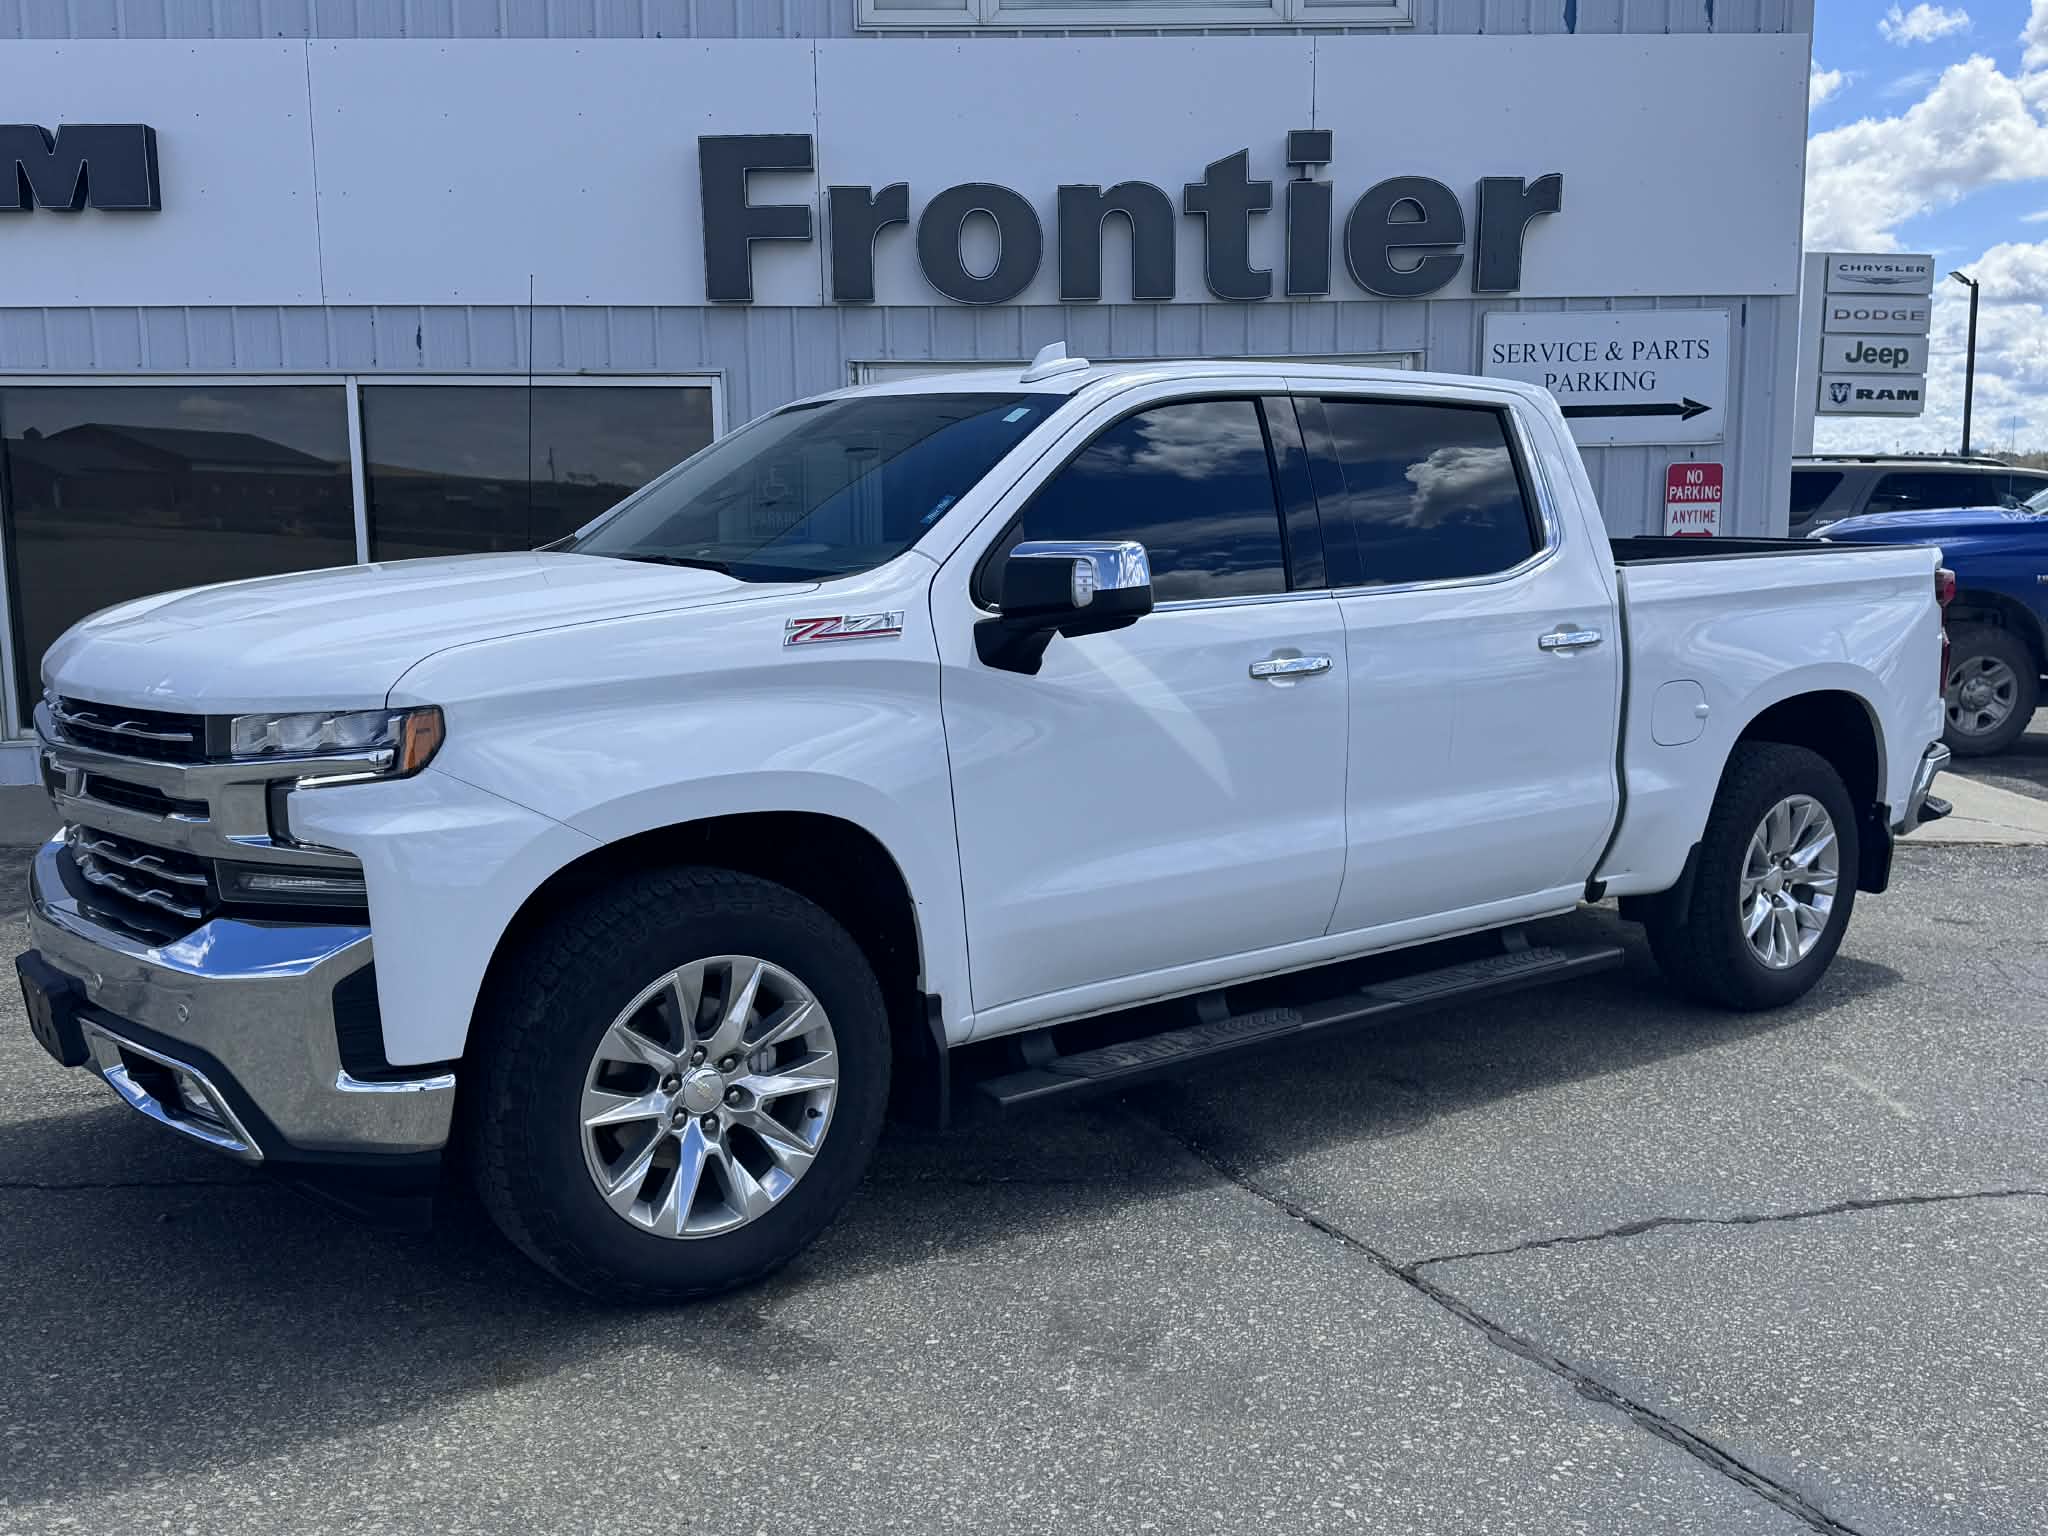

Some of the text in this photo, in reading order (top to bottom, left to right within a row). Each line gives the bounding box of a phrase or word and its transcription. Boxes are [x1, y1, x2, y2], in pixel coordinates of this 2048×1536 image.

[0, 124, 161, 210] M
[698, 129, 1563, 304] Frontier
[1839, 264, 1926, 273] CHRYSLER
[1834, 309, 1925, 321] DODGE
[1492, 339, 1710, 364] SERVICE & PARTS
[1845, 341, 1909, 368] Jeep
[1544, 370, 1656, 393] PARKING
[1856, 389, 1918, 400] RAM
[1686, 470, 1703, 484] NO
[1669, 485, 1721, 500] PARKING
[1671, 509, 1716, 523] ANYTIME
[784, 611, 904, 646] Z71
